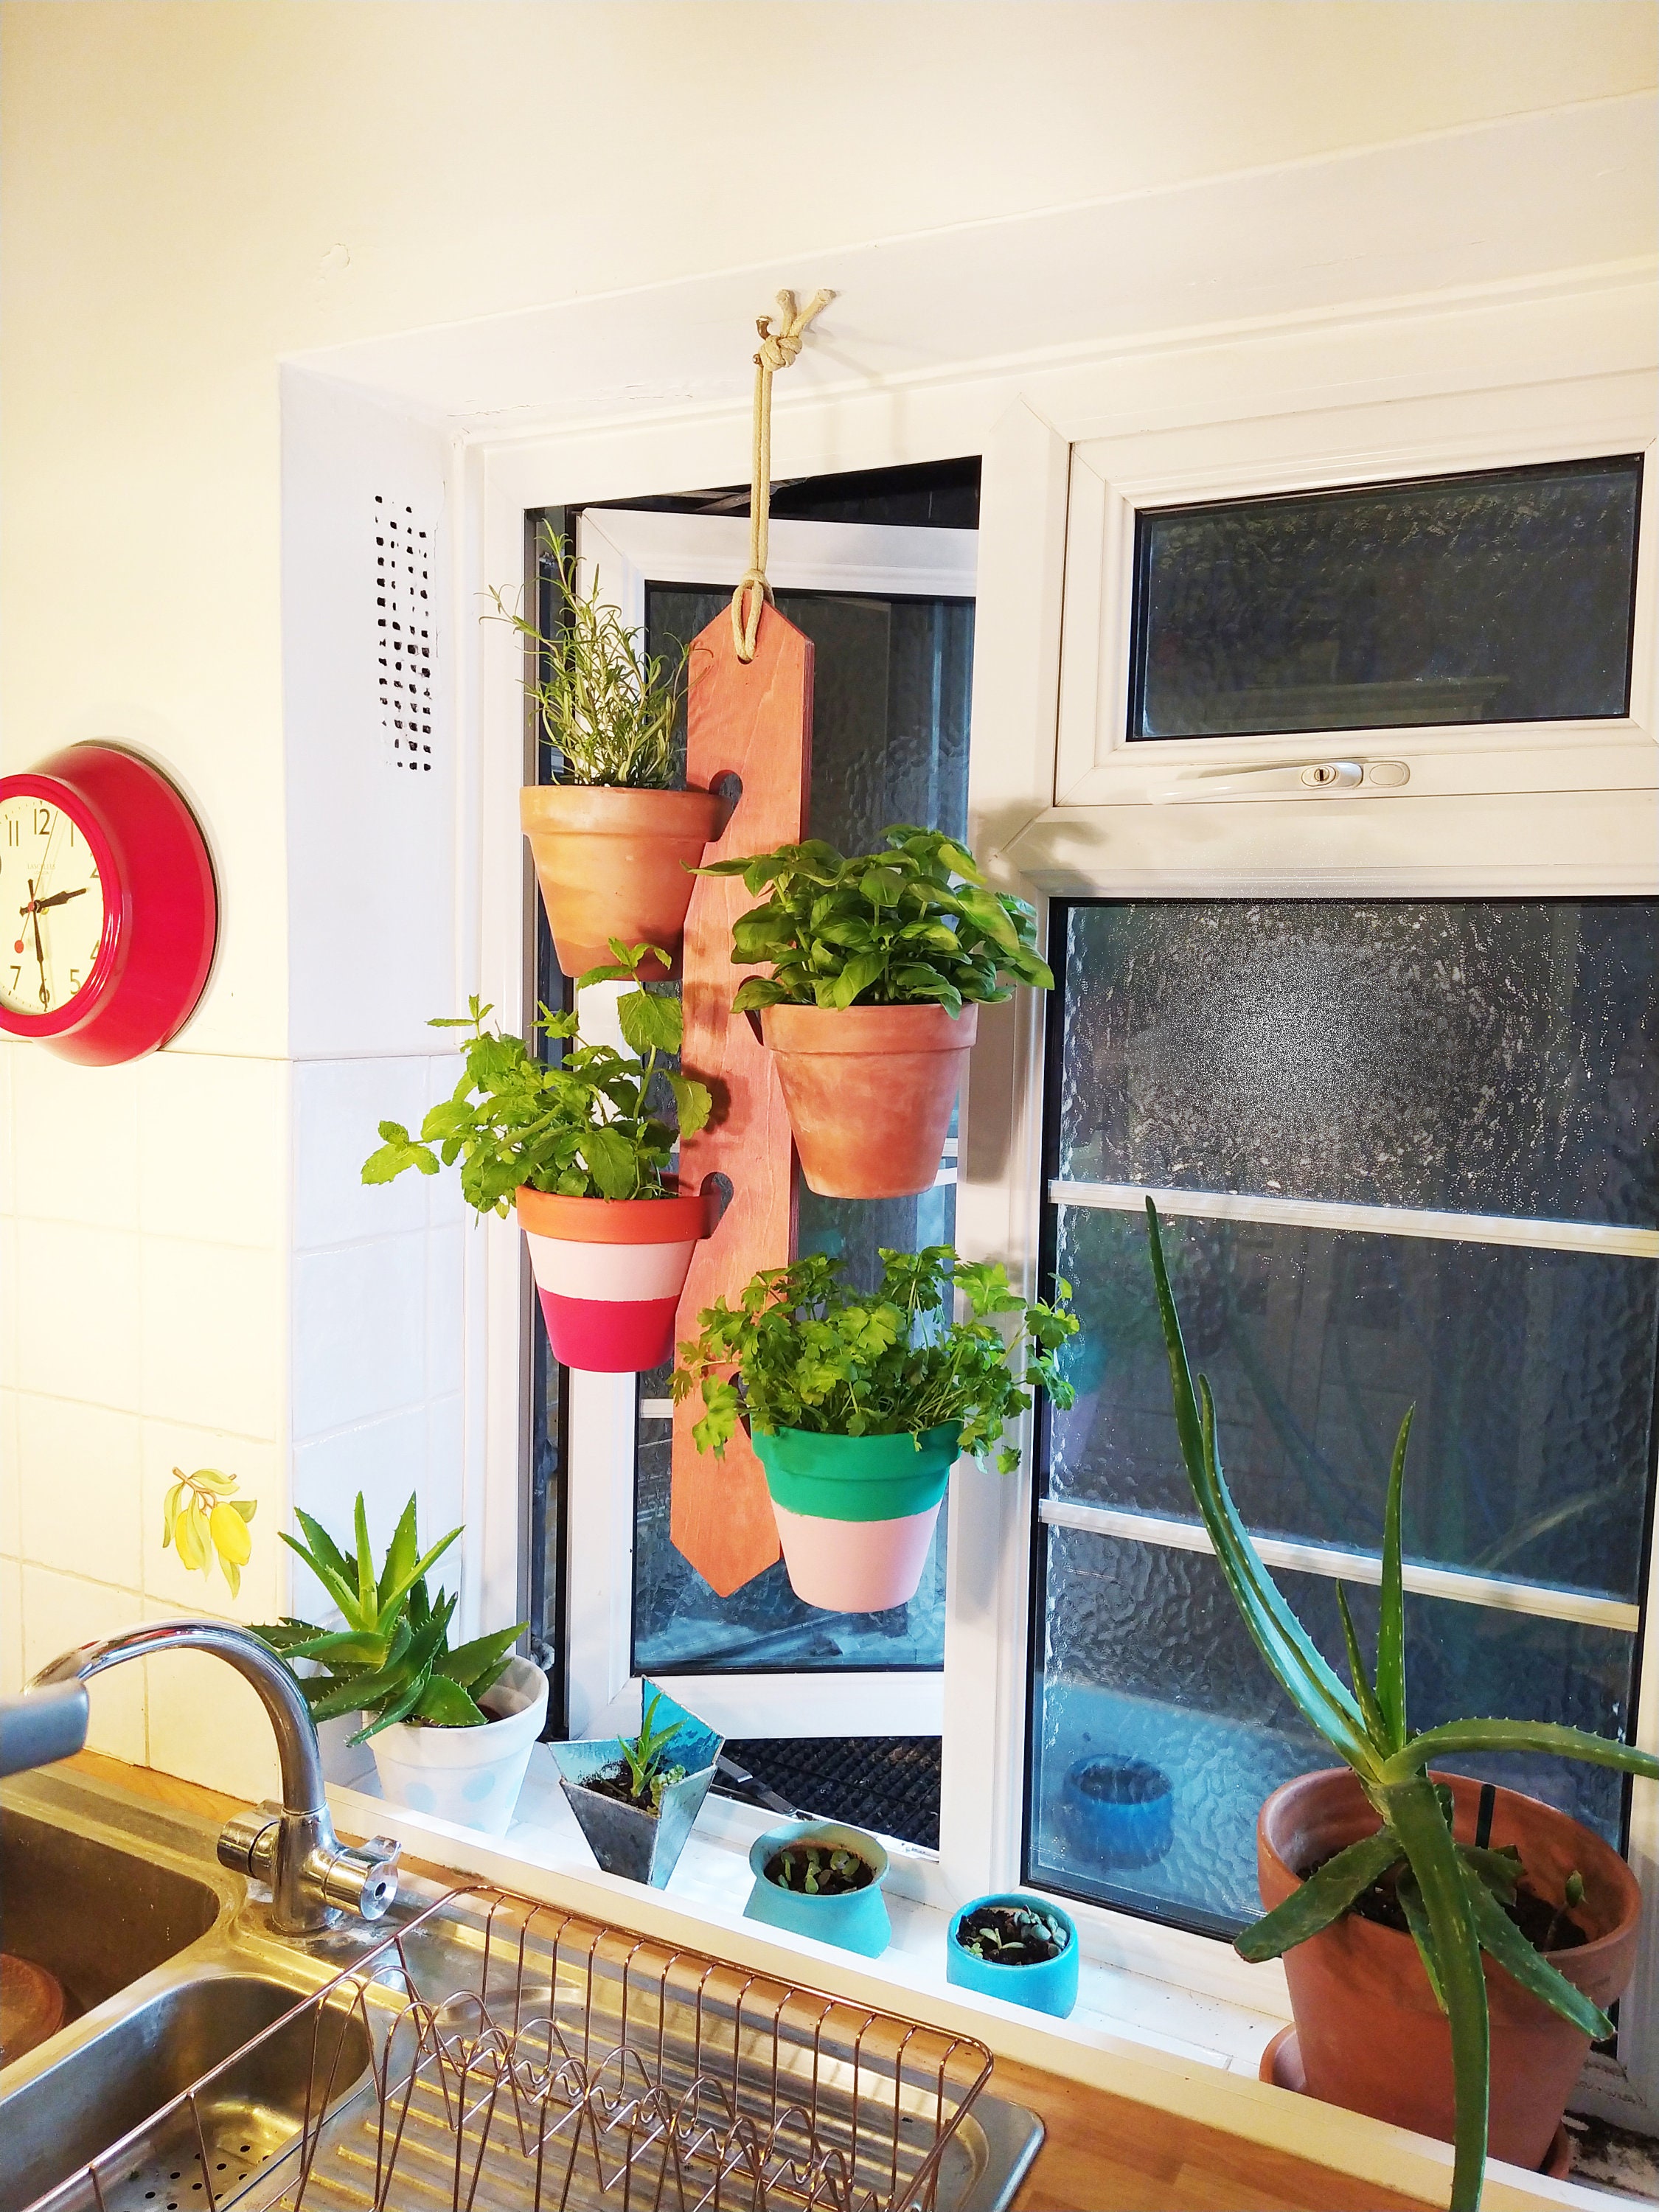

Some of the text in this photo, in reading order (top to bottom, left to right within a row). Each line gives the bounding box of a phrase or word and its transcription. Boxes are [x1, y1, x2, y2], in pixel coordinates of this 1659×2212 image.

[9, 821, 18, 846] 11
[34, 808, 50, 835] 12
[71, 821, 74, 847] 1
[10, 965, 21, 990] 7
[70, 969, 80, 995] 5
[39, 978, 50, 1004] 6
